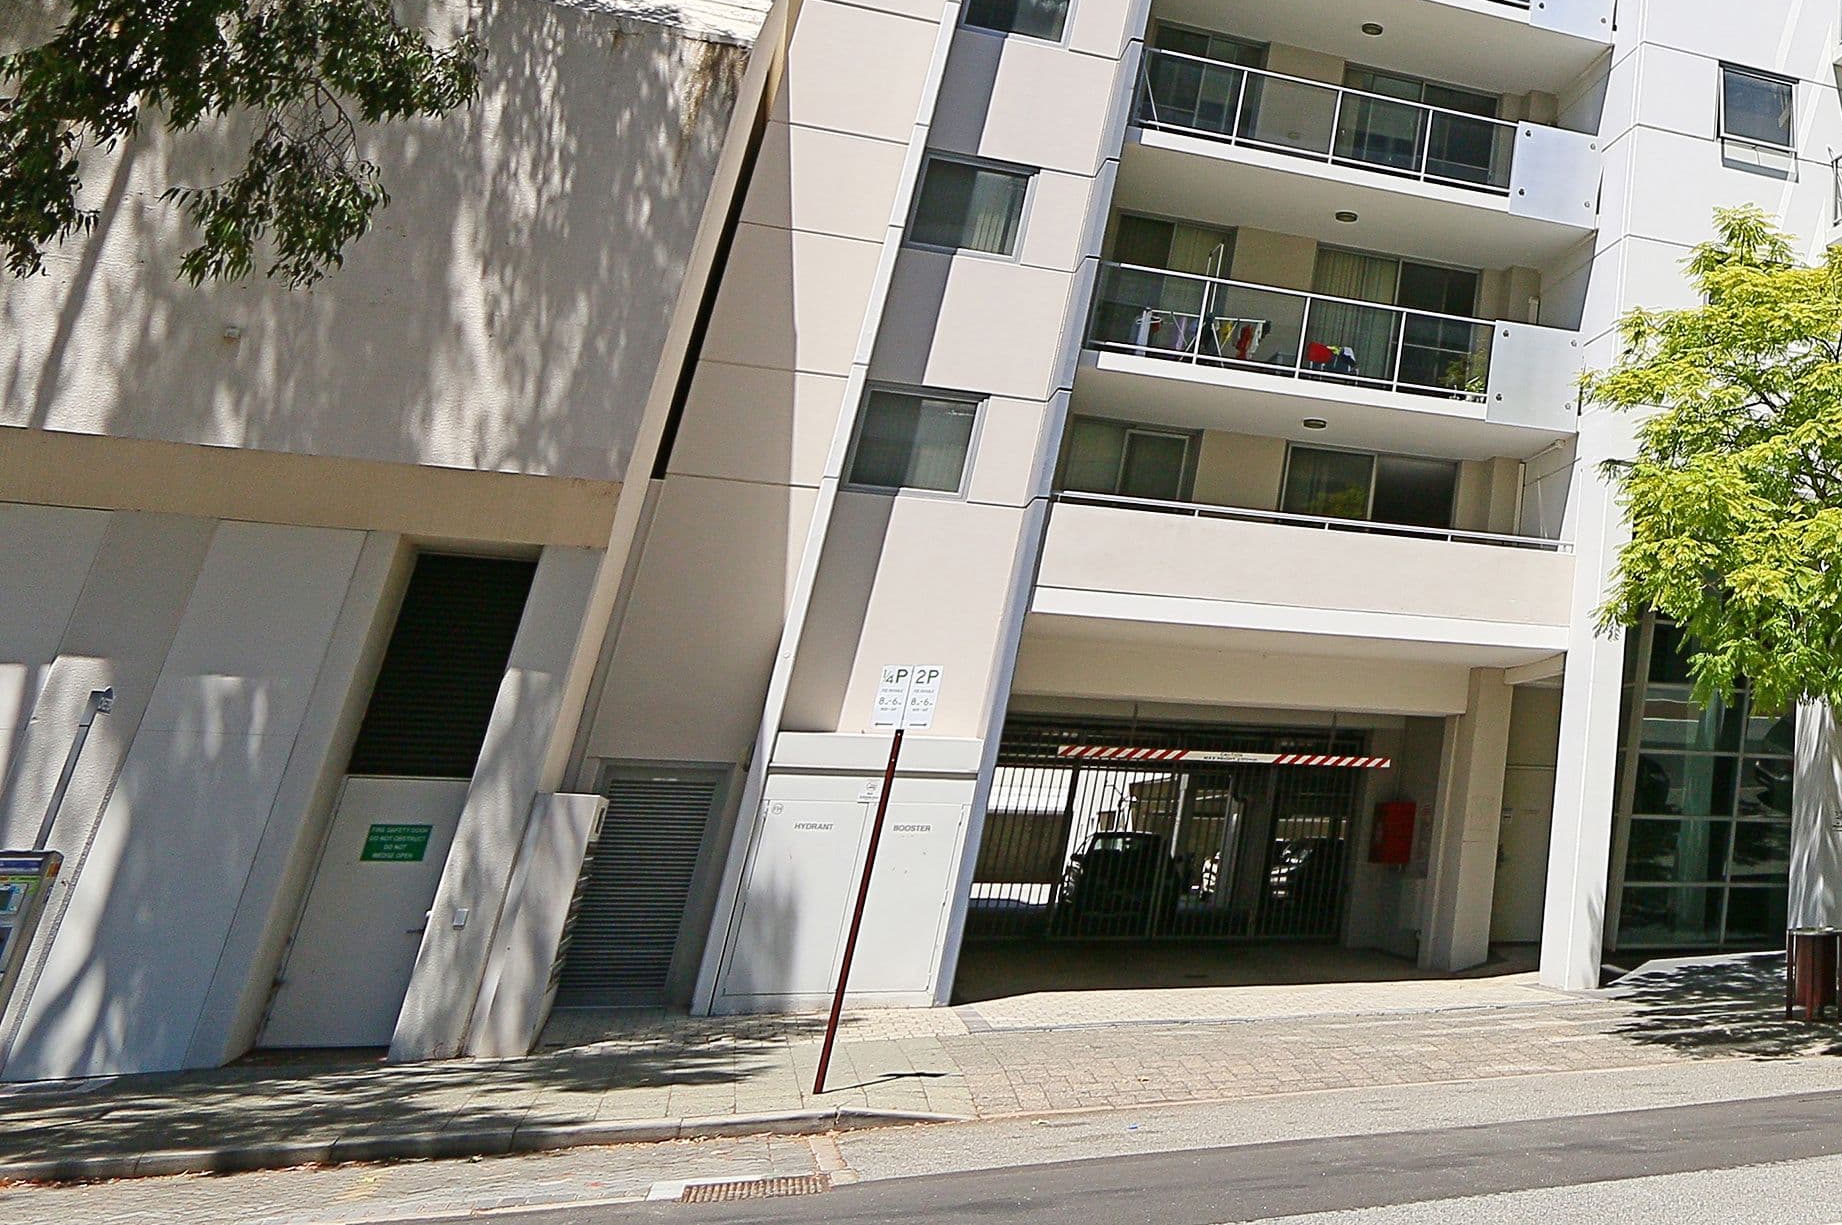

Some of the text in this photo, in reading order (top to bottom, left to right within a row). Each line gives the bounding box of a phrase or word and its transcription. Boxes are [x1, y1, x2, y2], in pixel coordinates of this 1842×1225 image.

[915, 669, 940, 684] 2P
[794, 822, 834, 831] HYDRANT
[893, 824, 931, 832] BOOSTER
